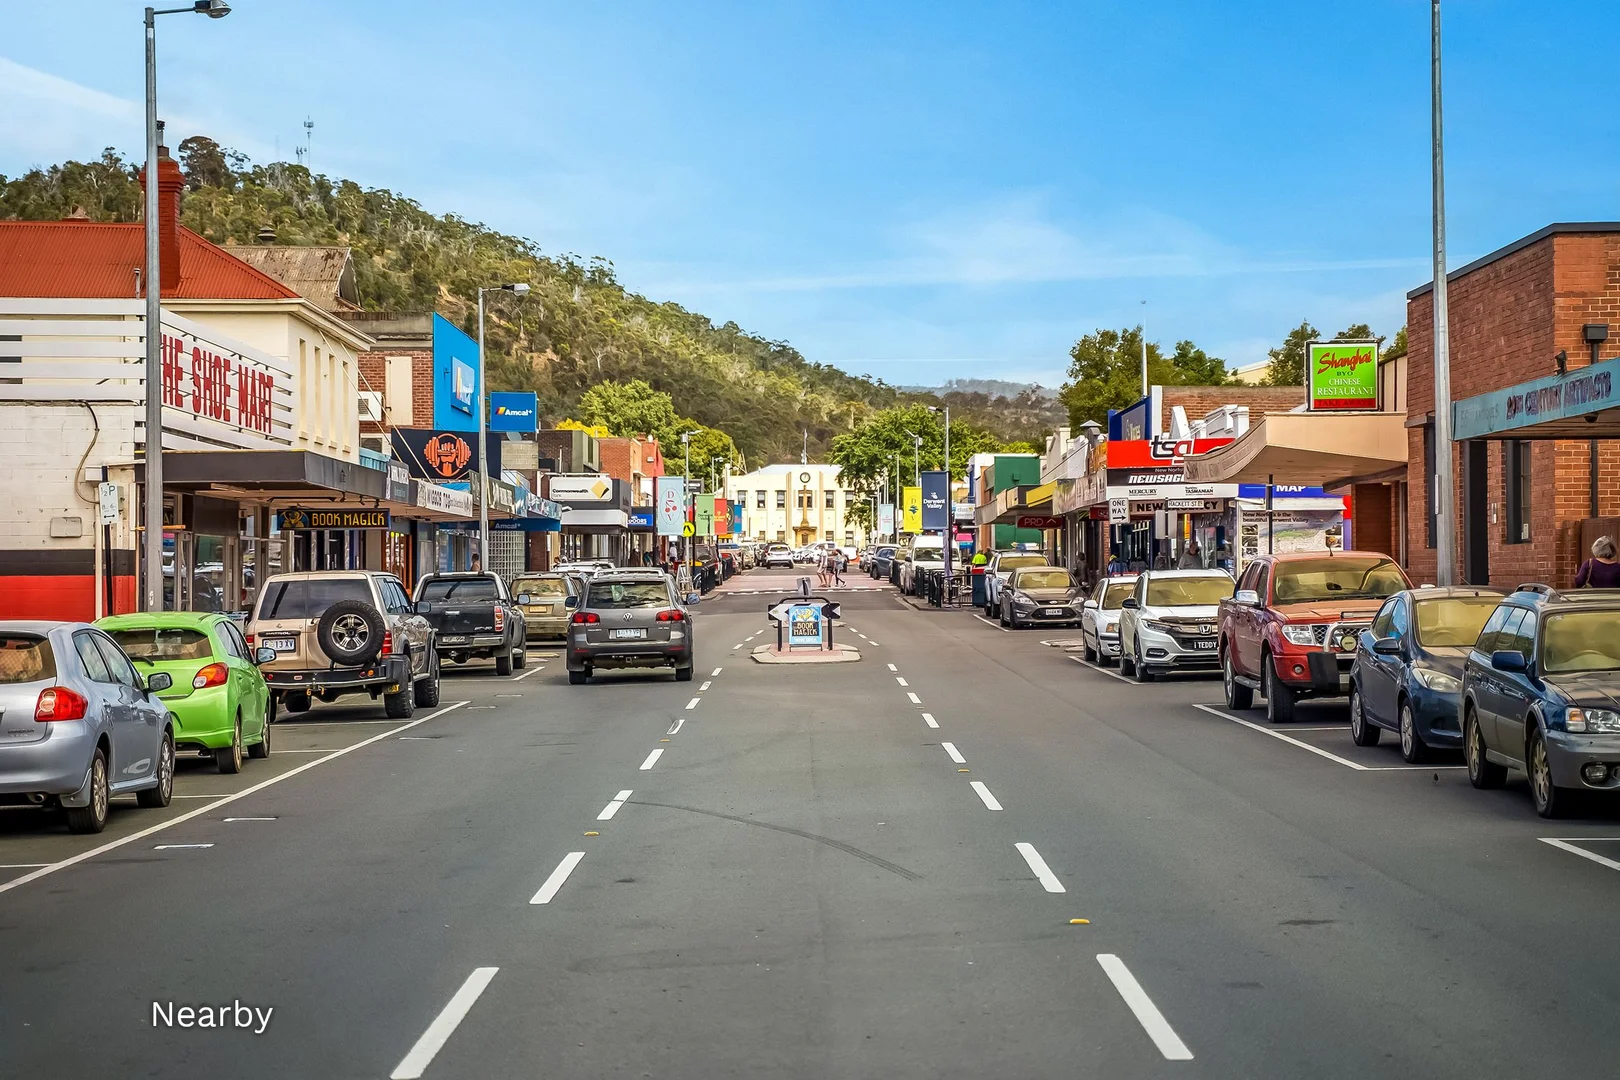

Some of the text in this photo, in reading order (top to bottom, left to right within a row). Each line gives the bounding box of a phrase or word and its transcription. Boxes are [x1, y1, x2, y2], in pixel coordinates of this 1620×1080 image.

[1317, 348, 1372, 374] Shanghai
[160, 332, 273, 434] HE SHOE MART
[1328, 378, 1360, 386] CHINESE
[1317, 386, 1374, 396] RESTAURANT
[1524, 384, 1563, 416] CENTURY
[1563, 371, 1612, 409] ARTIFACTS
[311, 512, 386, 526] BOOK MAGICK
[1024, 518, 1044, 526] PRD
[796, 622, 814, 630] BOOK
[1198, 640, 1217, 649] TEDDY
